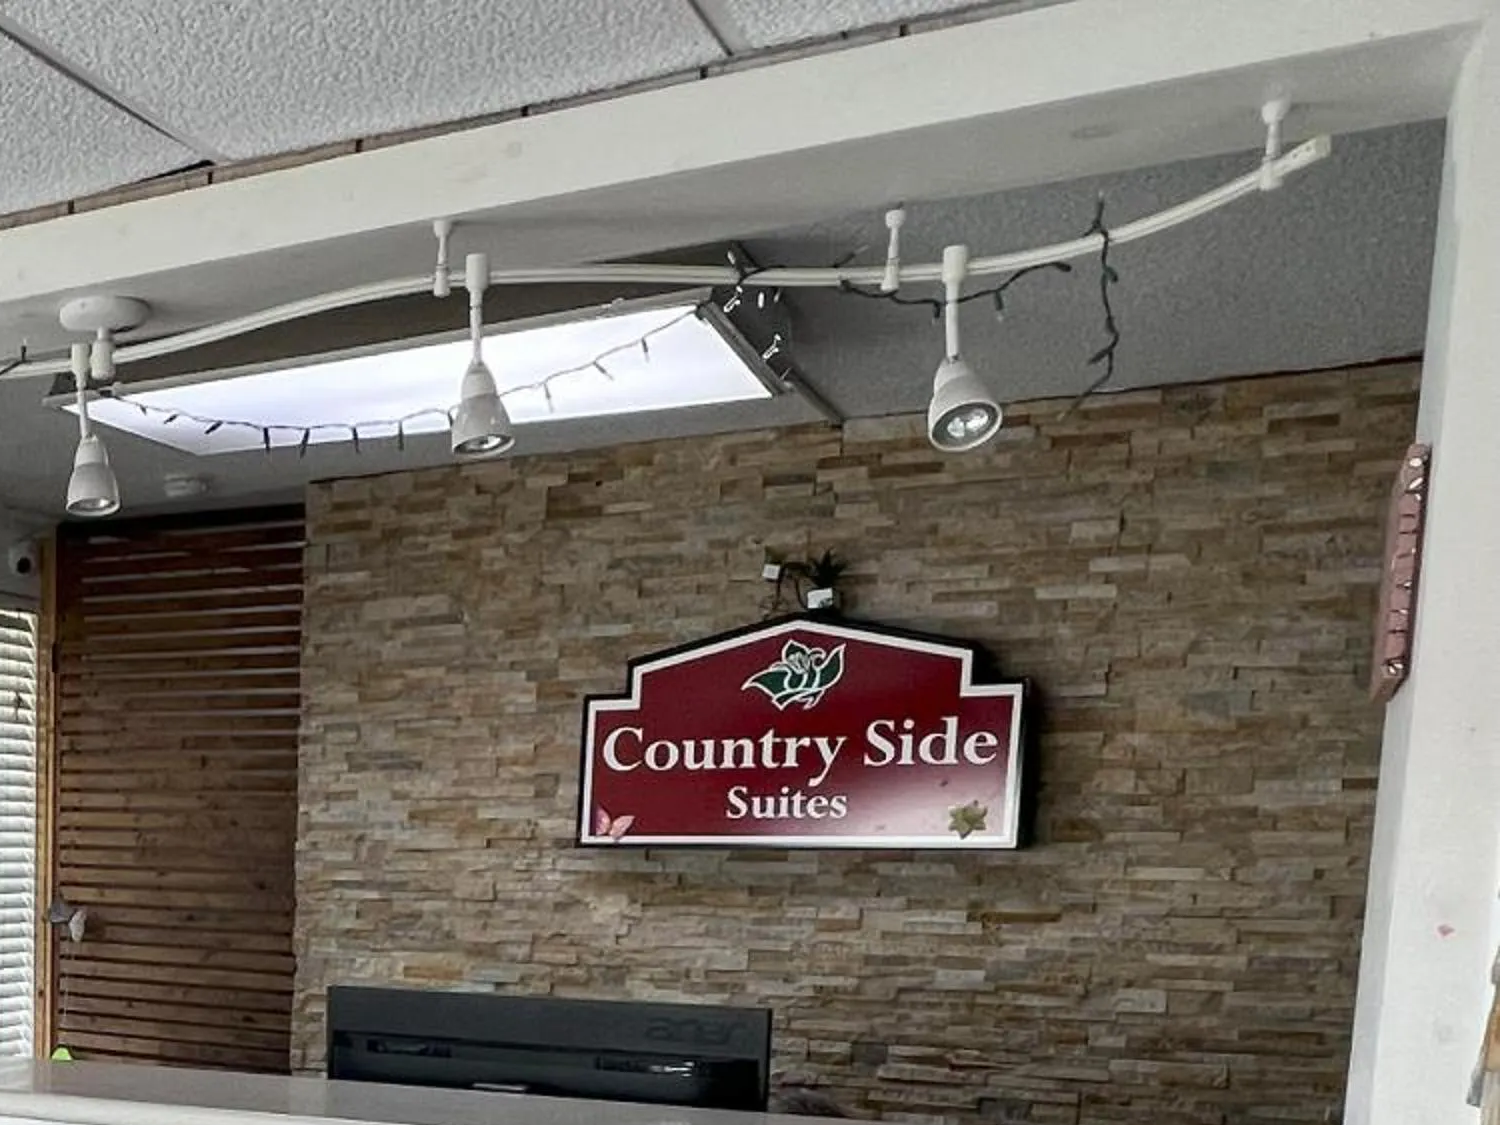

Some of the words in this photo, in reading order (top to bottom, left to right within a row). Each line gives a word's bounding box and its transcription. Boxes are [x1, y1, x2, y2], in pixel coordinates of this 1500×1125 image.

[602, 726, 847, 787] Country
[863, 716, 999, 768] Side
[726, 786, 848, 819] Suites
[645, 1016, 748, 1045] acer
